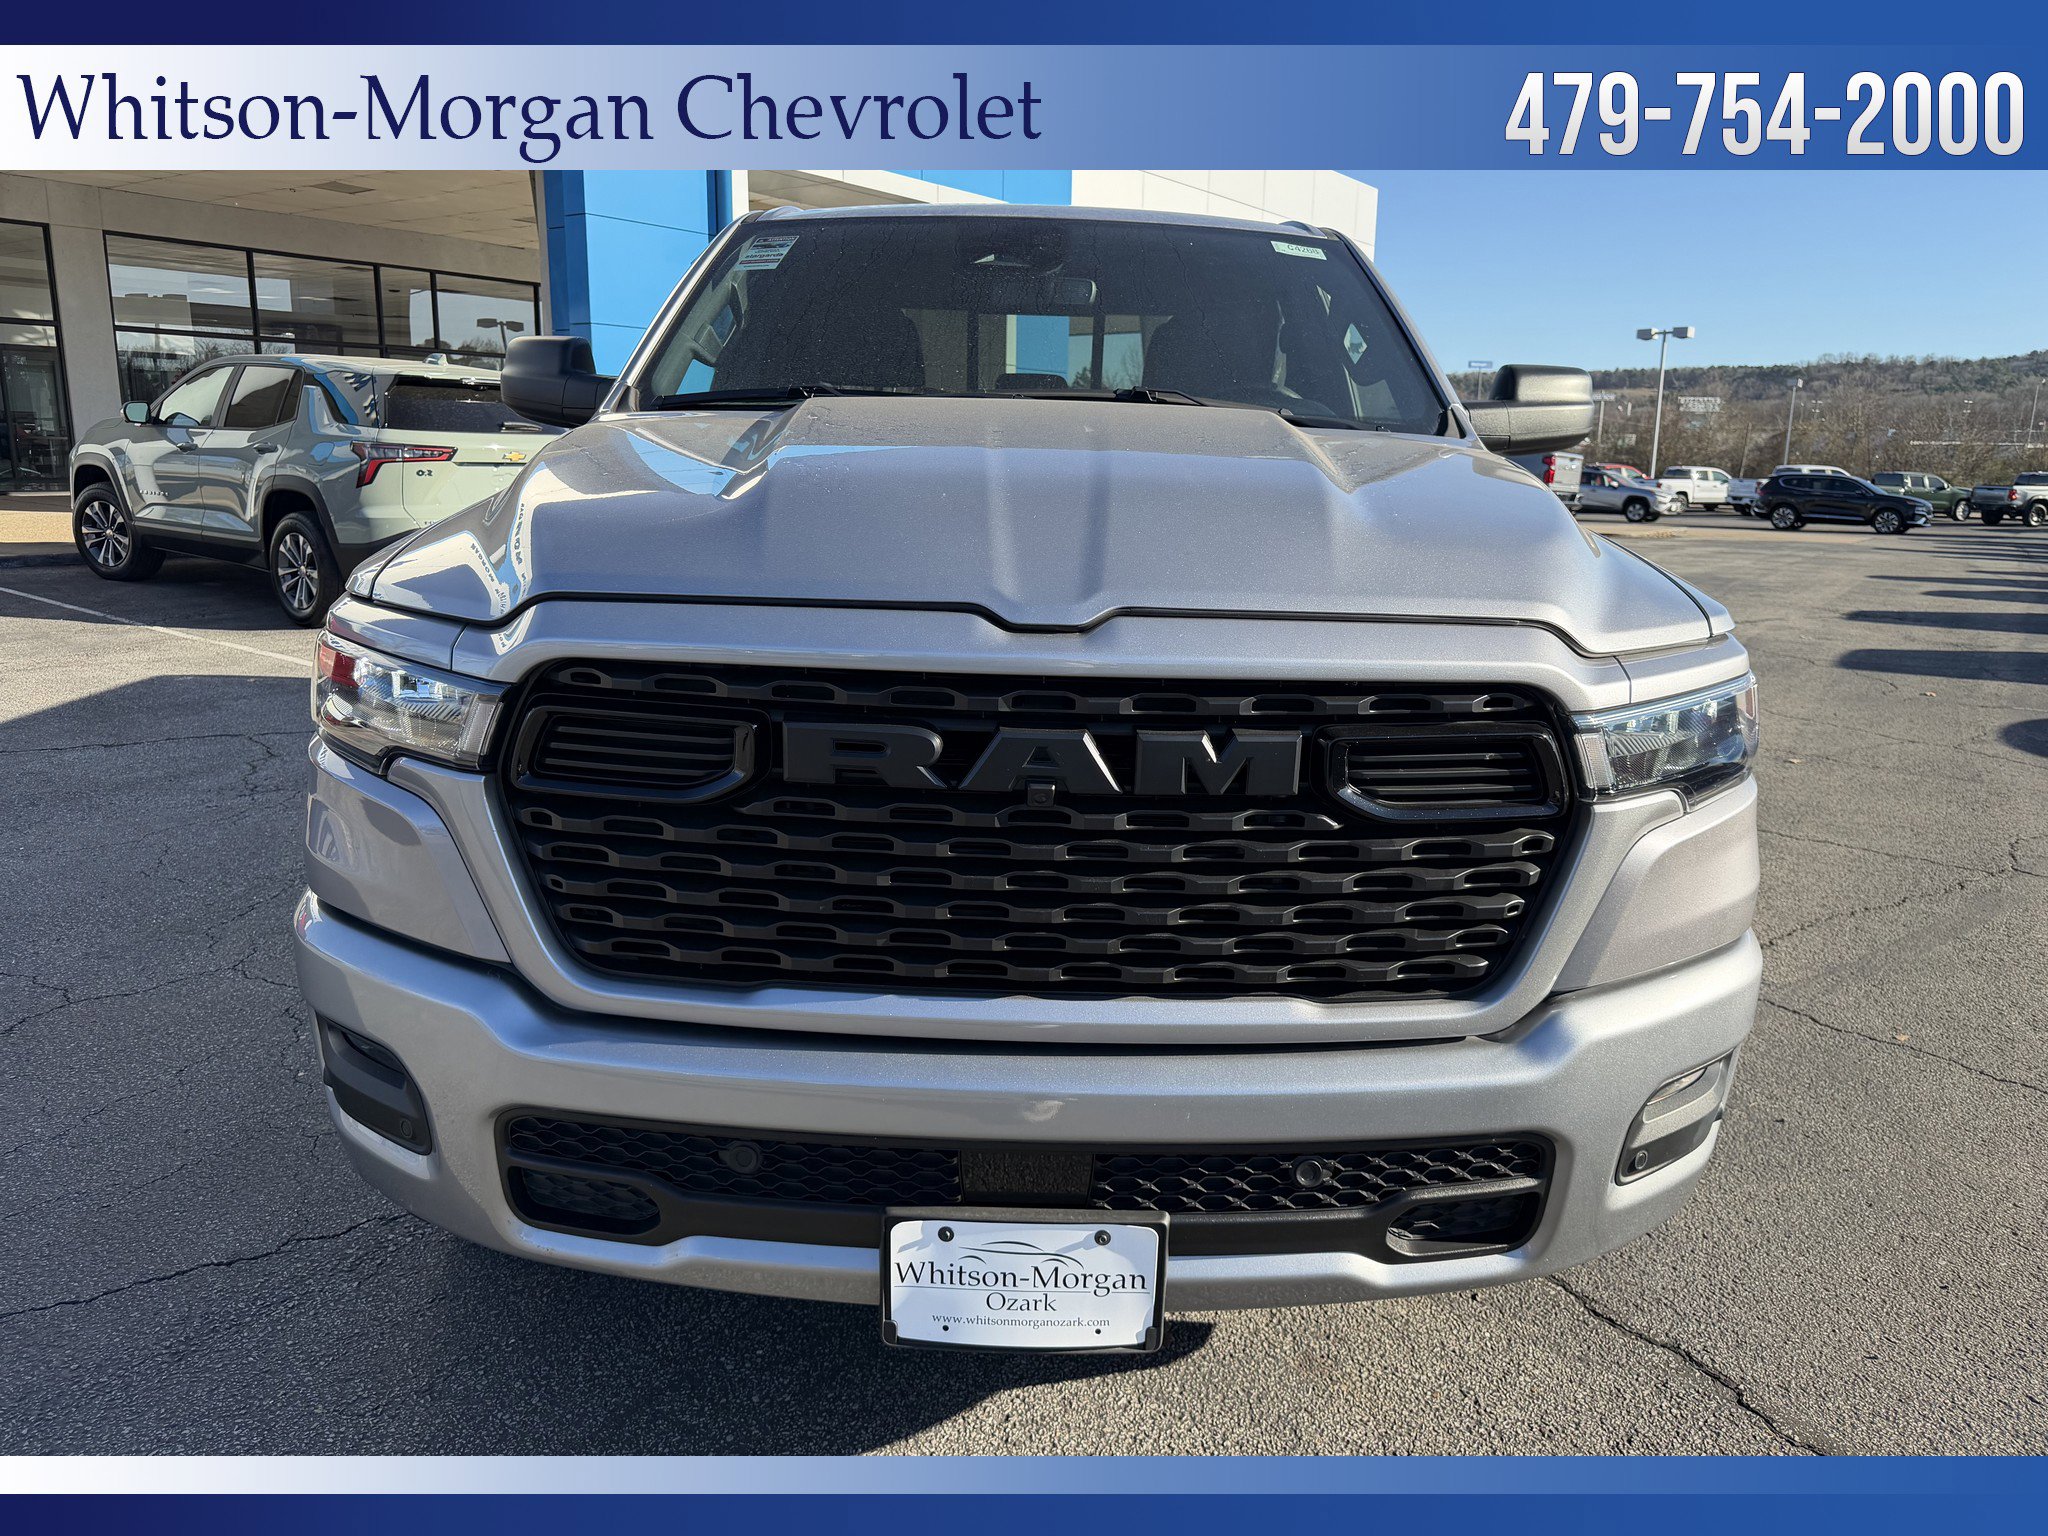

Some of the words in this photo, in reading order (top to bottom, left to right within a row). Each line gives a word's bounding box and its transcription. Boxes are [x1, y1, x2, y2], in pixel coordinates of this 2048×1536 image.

[783, 721, 1303, 795] RAM
[894, 1261, 1147, 1297] Whitson-Morgan
[986, 1292, 1057, 1312] Ozark
[932, 1314, 1110, 1329] www.whitsonmorganozark.com
